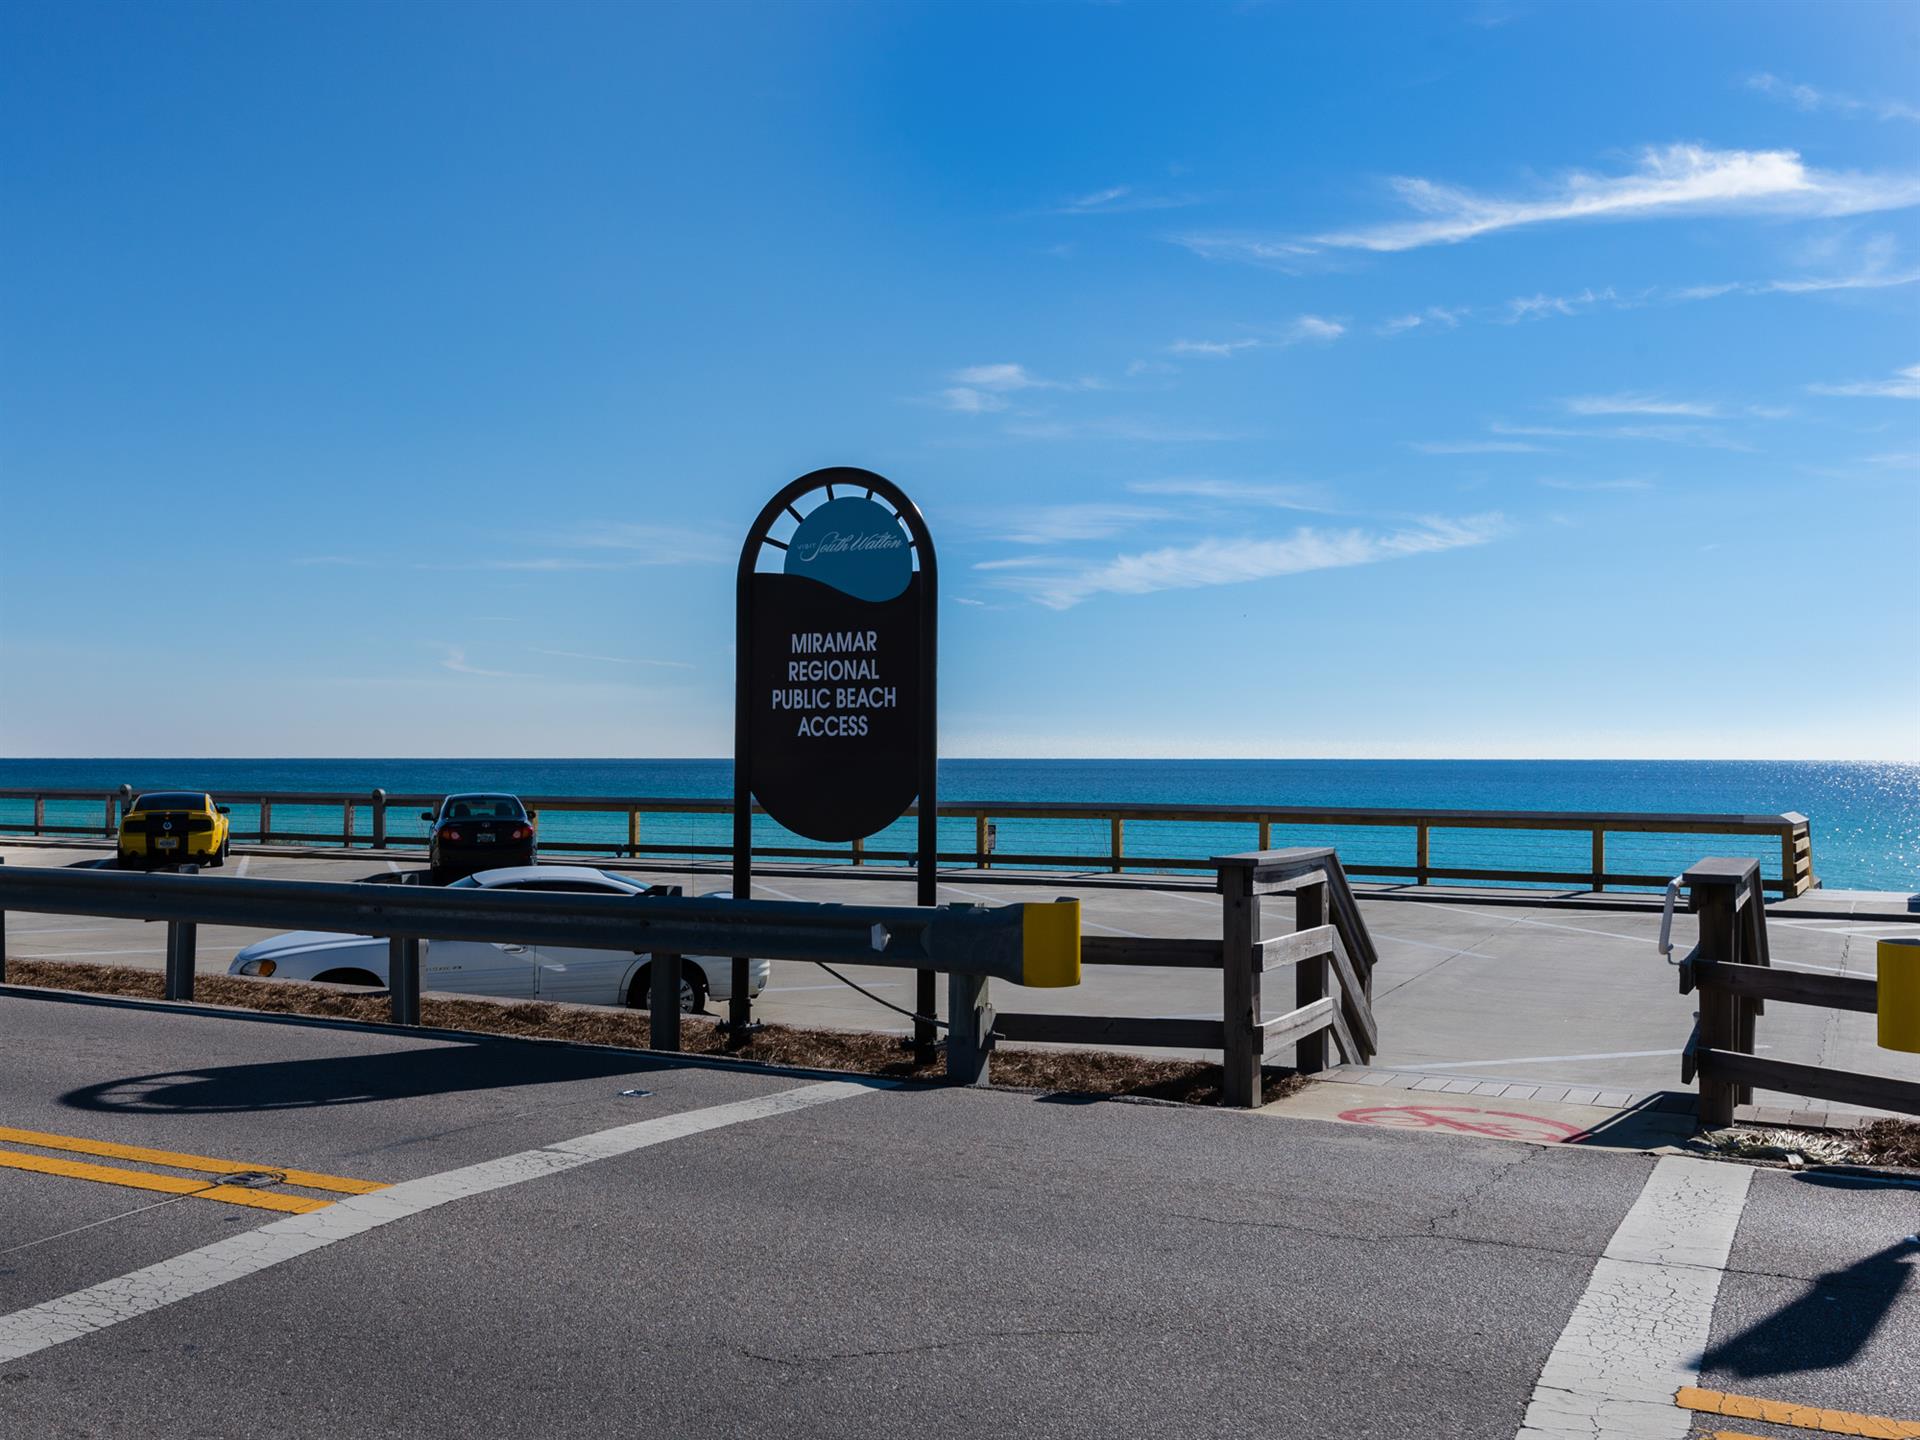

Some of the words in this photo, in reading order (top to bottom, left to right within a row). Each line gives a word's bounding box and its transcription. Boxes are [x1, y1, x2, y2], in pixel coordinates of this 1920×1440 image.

[800, 531, 854, 562] South
[850, 531, 902, 552] Walton
[791, 631, 878, 654] MIRAMAR
[788, 659, 880, 682] REGIONAL
[772, 688, 831, 710] PUBLIC
[836, 687, 896, 708] BEACH
[797, 715, 868, 737] ACCESS
